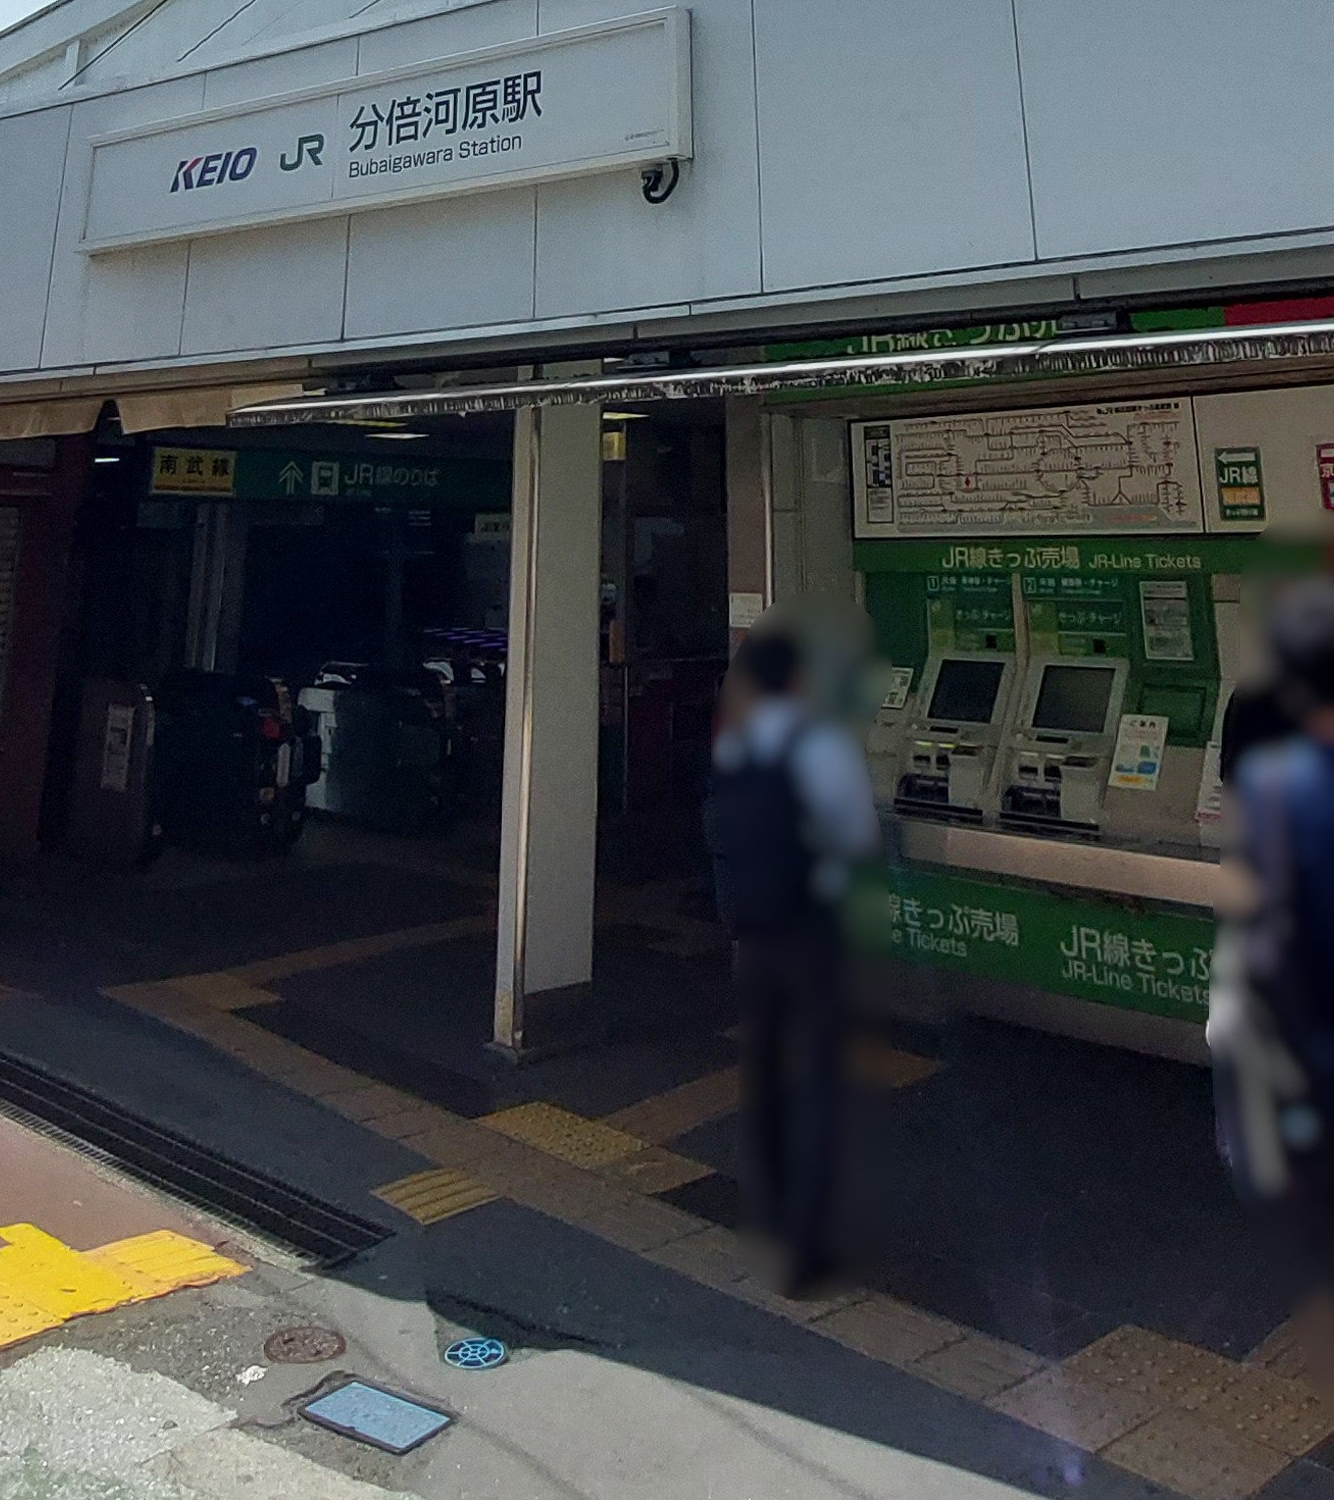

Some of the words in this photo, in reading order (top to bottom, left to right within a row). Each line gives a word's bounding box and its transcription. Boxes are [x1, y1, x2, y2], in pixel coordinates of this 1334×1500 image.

[348, 70, 543, 154] 分倍河原駅
[169, 146, 258, 193] KEIO
[280, 133, 325, 172] JR
[348, 145, 453, 180] Bubaigawara
[458, 133, 523, 160] Station
[160, 454, 230, 477] 南武線
[344, 462, 439, 487] JR線のりば
[1219, 465, 1258, 484] JR線
[942, 546, 1081, 569] JR線きっぷ売場
[1088, 553, 1141, 569] JR-Line
[1146, 553, 1201, 569] Tickets
[909, 928, 968, 957] Tickets
[1061, 959, 1133, 991] JR-Line
[1139, 973, 1210, 1006] Tickets
